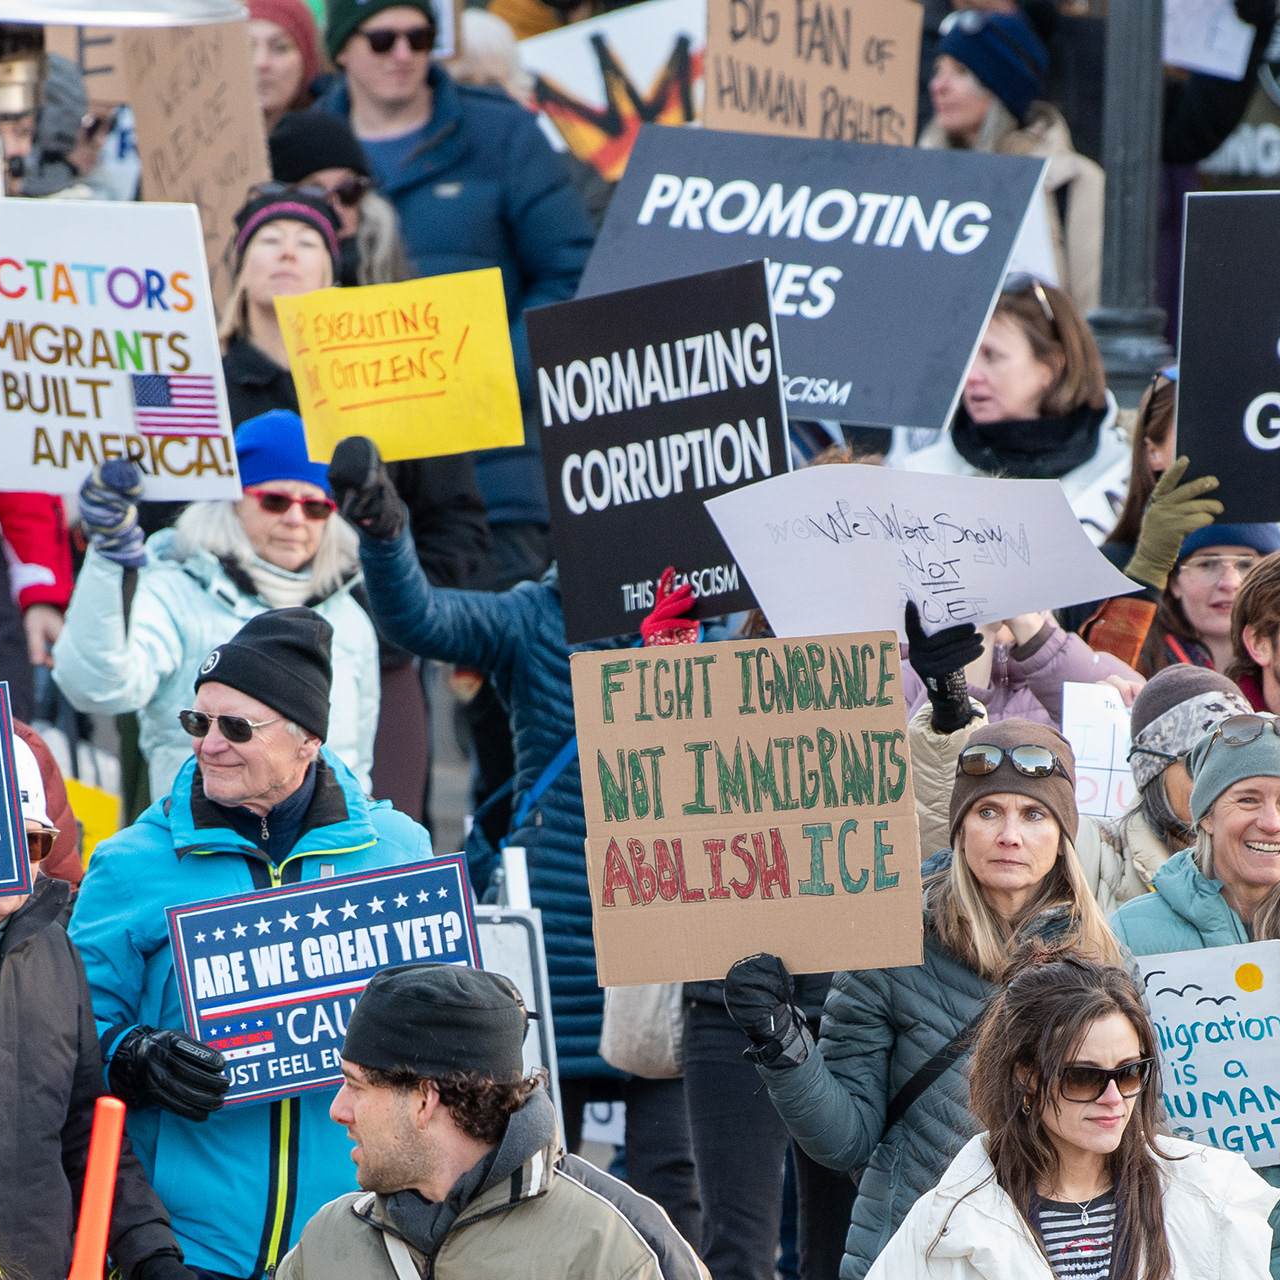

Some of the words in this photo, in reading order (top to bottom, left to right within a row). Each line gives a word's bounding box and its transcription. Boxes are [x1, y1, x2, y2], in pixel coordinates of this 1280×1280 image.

[796, 0, 851, 72] FAN
[864, 35, 897, 74] OF
[713, 55, 807, 130] HUMAN
[820, 85, 907, 147] RIGHTS
[637, 173, 993, 256] PROMOTING
[313, 301, 440, 345] EXECUTING
[2, 370, 113, 420] BUILT
[537, 322, 772, 428] NORMALIZING
[31, 425, 236, 480] AMERICA!
[561, 416, 771, 515] CORRUPTION
[809, 501, 870, 544] We
[867, 503, 935, 544] Want
[933, 513, 1004, 544] Snow
[621, 579, 655, 612] THIS
[901, 549, 961, 579] NOT
[600, 653, 716, 725] FIGHT
[733, 640, 897, 715] IGNORANCE
[596, 745, 665, 824] NOT
[681, 725, 908, 816] IMMIGRANTS
[603, 826, 791, 908] ABOLISH
[798, 818, 900, 897] ICE
[194, 952, 250, 1000] ARE
[249, 941, 300, 988] WE
[301, 924, 389, 980] GREAT
[391, 911, 463, 961] YET?
[222, 1062, 261, 1088] UST
[268, 1053, 316, 1078] FEEL
[1171, 1061, 1198, 1086] is
[1223, 1059, 1249, 1079] a
